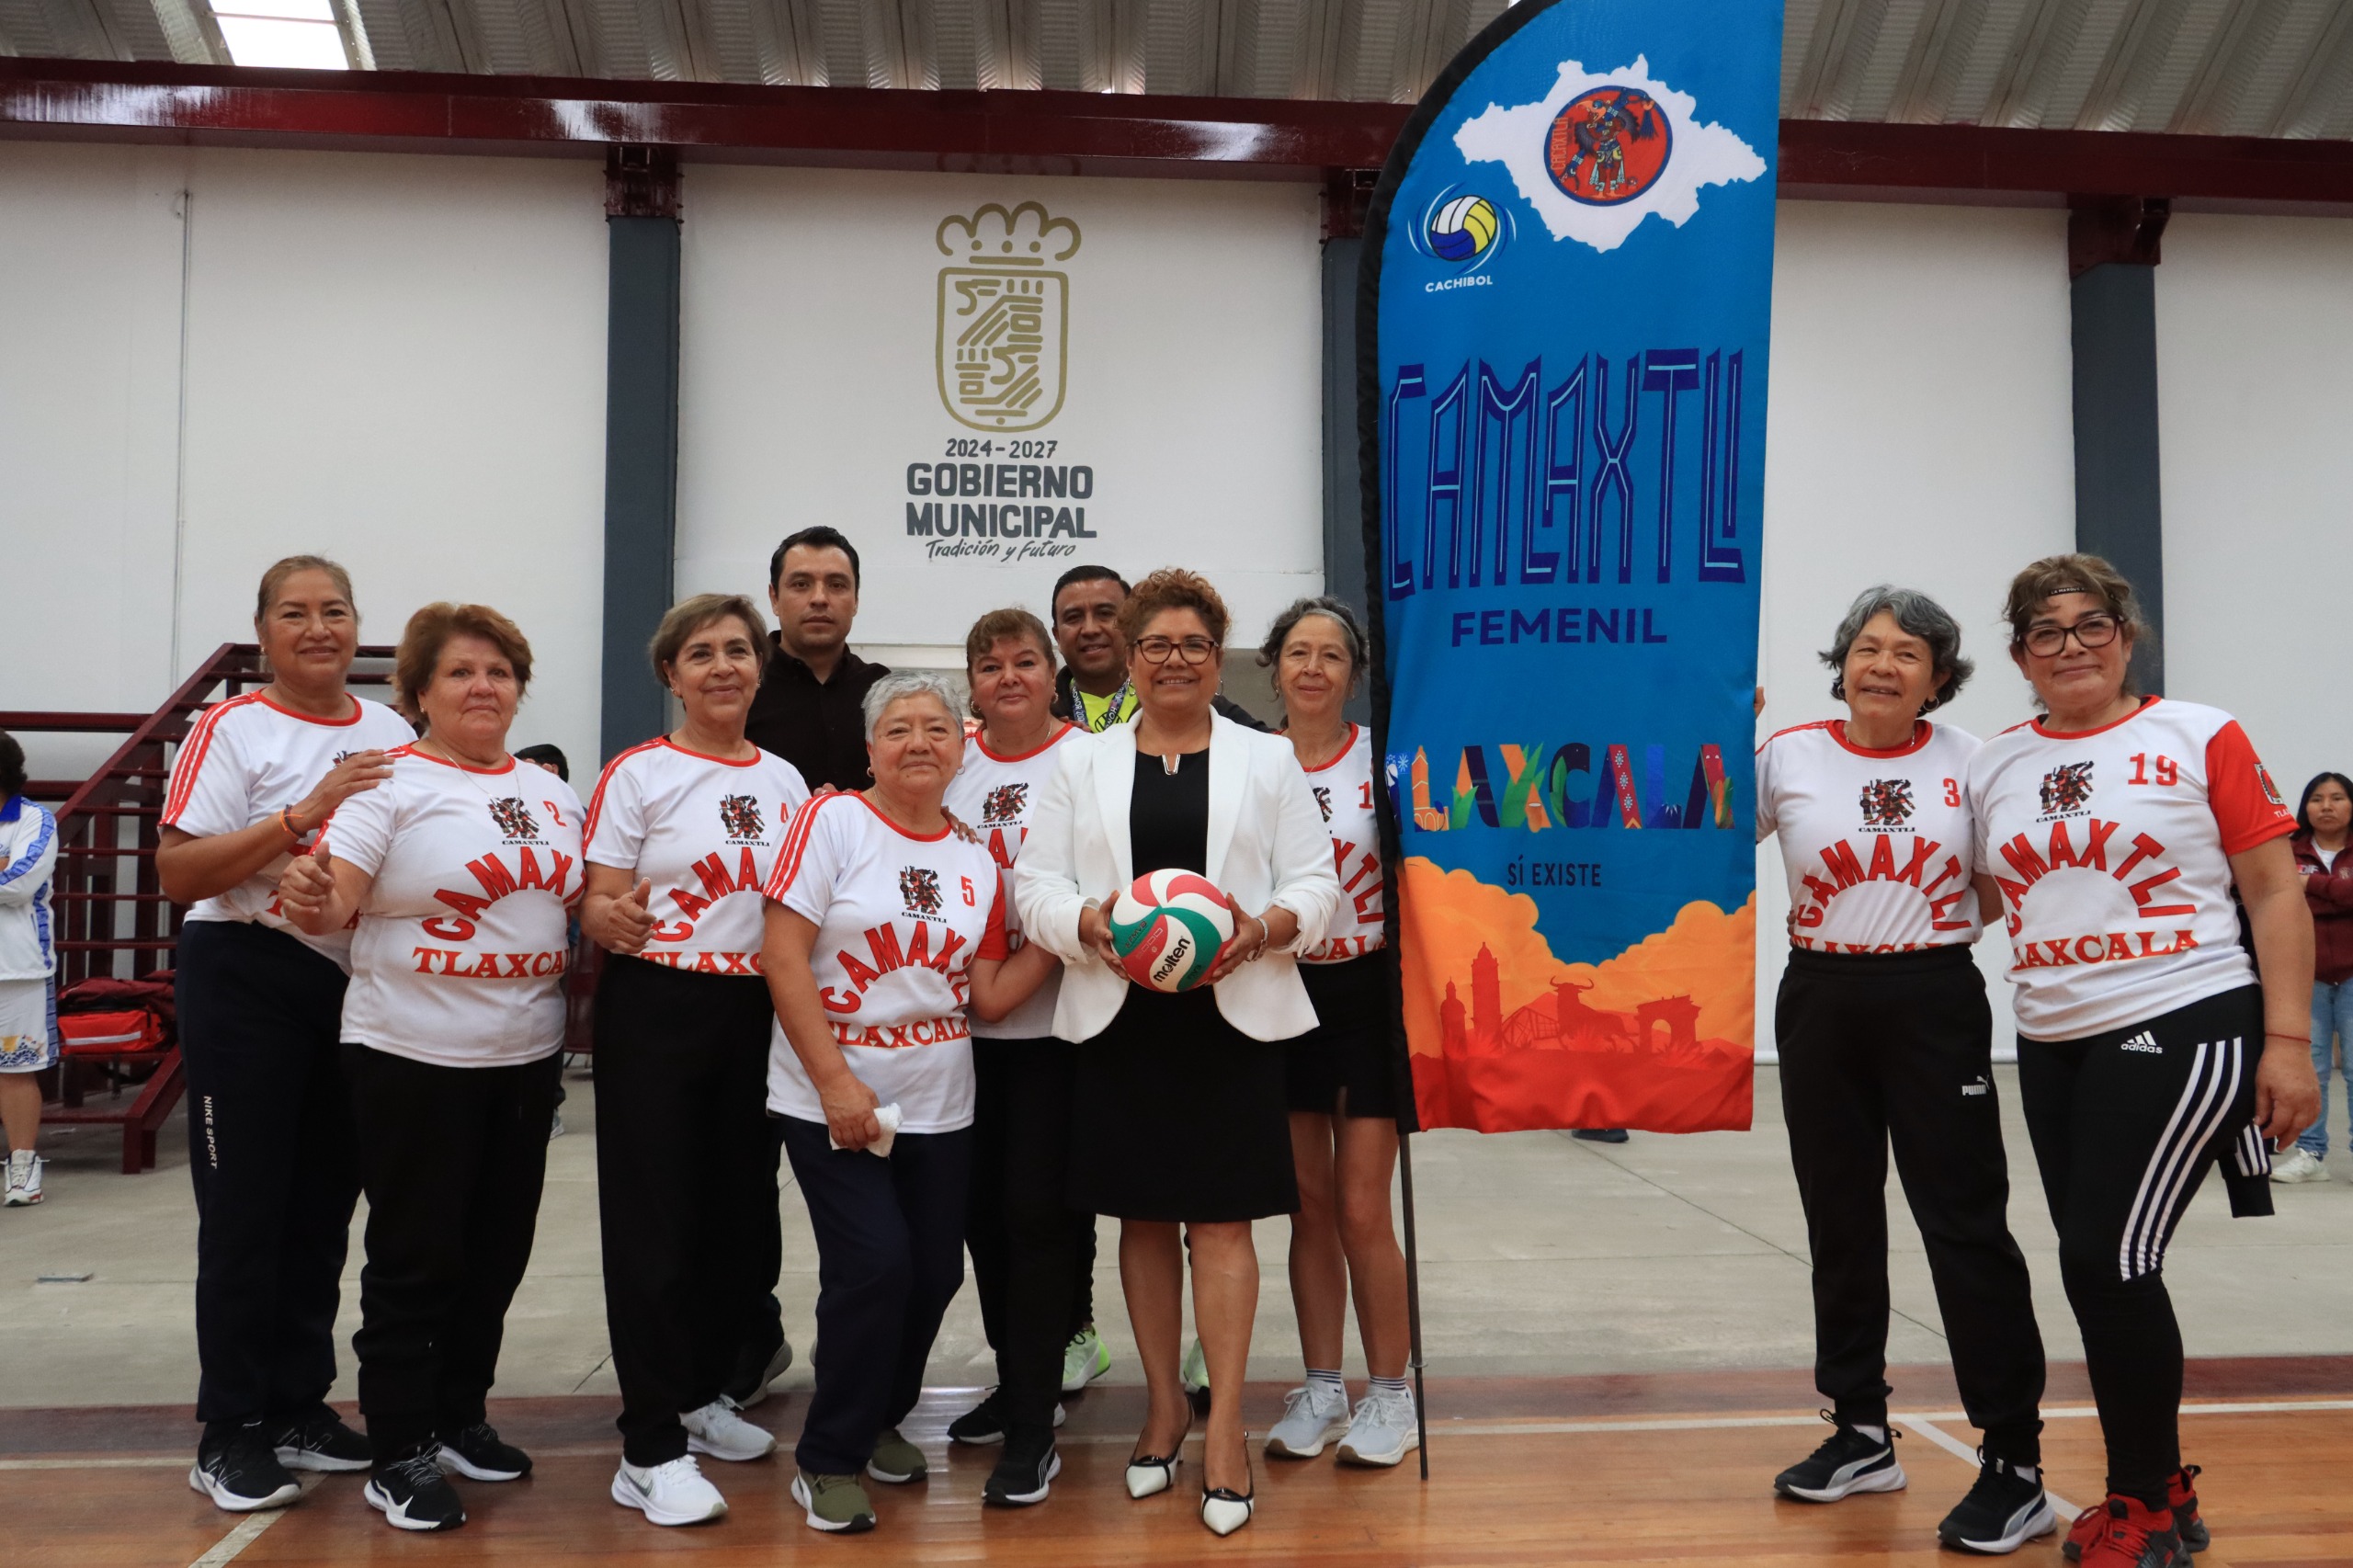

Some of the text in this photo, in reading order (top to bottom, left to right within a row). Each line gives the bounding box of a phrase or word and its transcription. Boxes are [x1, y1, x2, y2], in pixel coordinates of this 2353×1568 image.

[1425, 275, 1494, 292] CACHIBOL
[907, 463, 1093, 499] GOBIERNO
[906, 503, 1097, 539] MUNICIPAL
[926, 539, 1000, 559] Tradición
[1001, 546, 1017, 562] y
[1451, 608, 1667, 647] FEMENIL
[2128, 753, 2178, 787] 19
[1942, 778, 1961, 808] 3
[542, 801, 567, 827] 2
[977, 820, 1023, 829] CAMAXTLI
[2036, 810, 2091, 824] CAMAXTLI
[1507, 855, 1601, 888] SÍ EXISTE
[1796, 834, 1972, 931] CAMAXTLI
[961, 875, 975, 906] 5
[901, 911, 948, 924] CAMAXTLI
[1153, 937, 1190, 983] molten
[2120, 1043, 2163, 1054] adidas
[203, 1096, 218, 1169] NIKE SPORT
